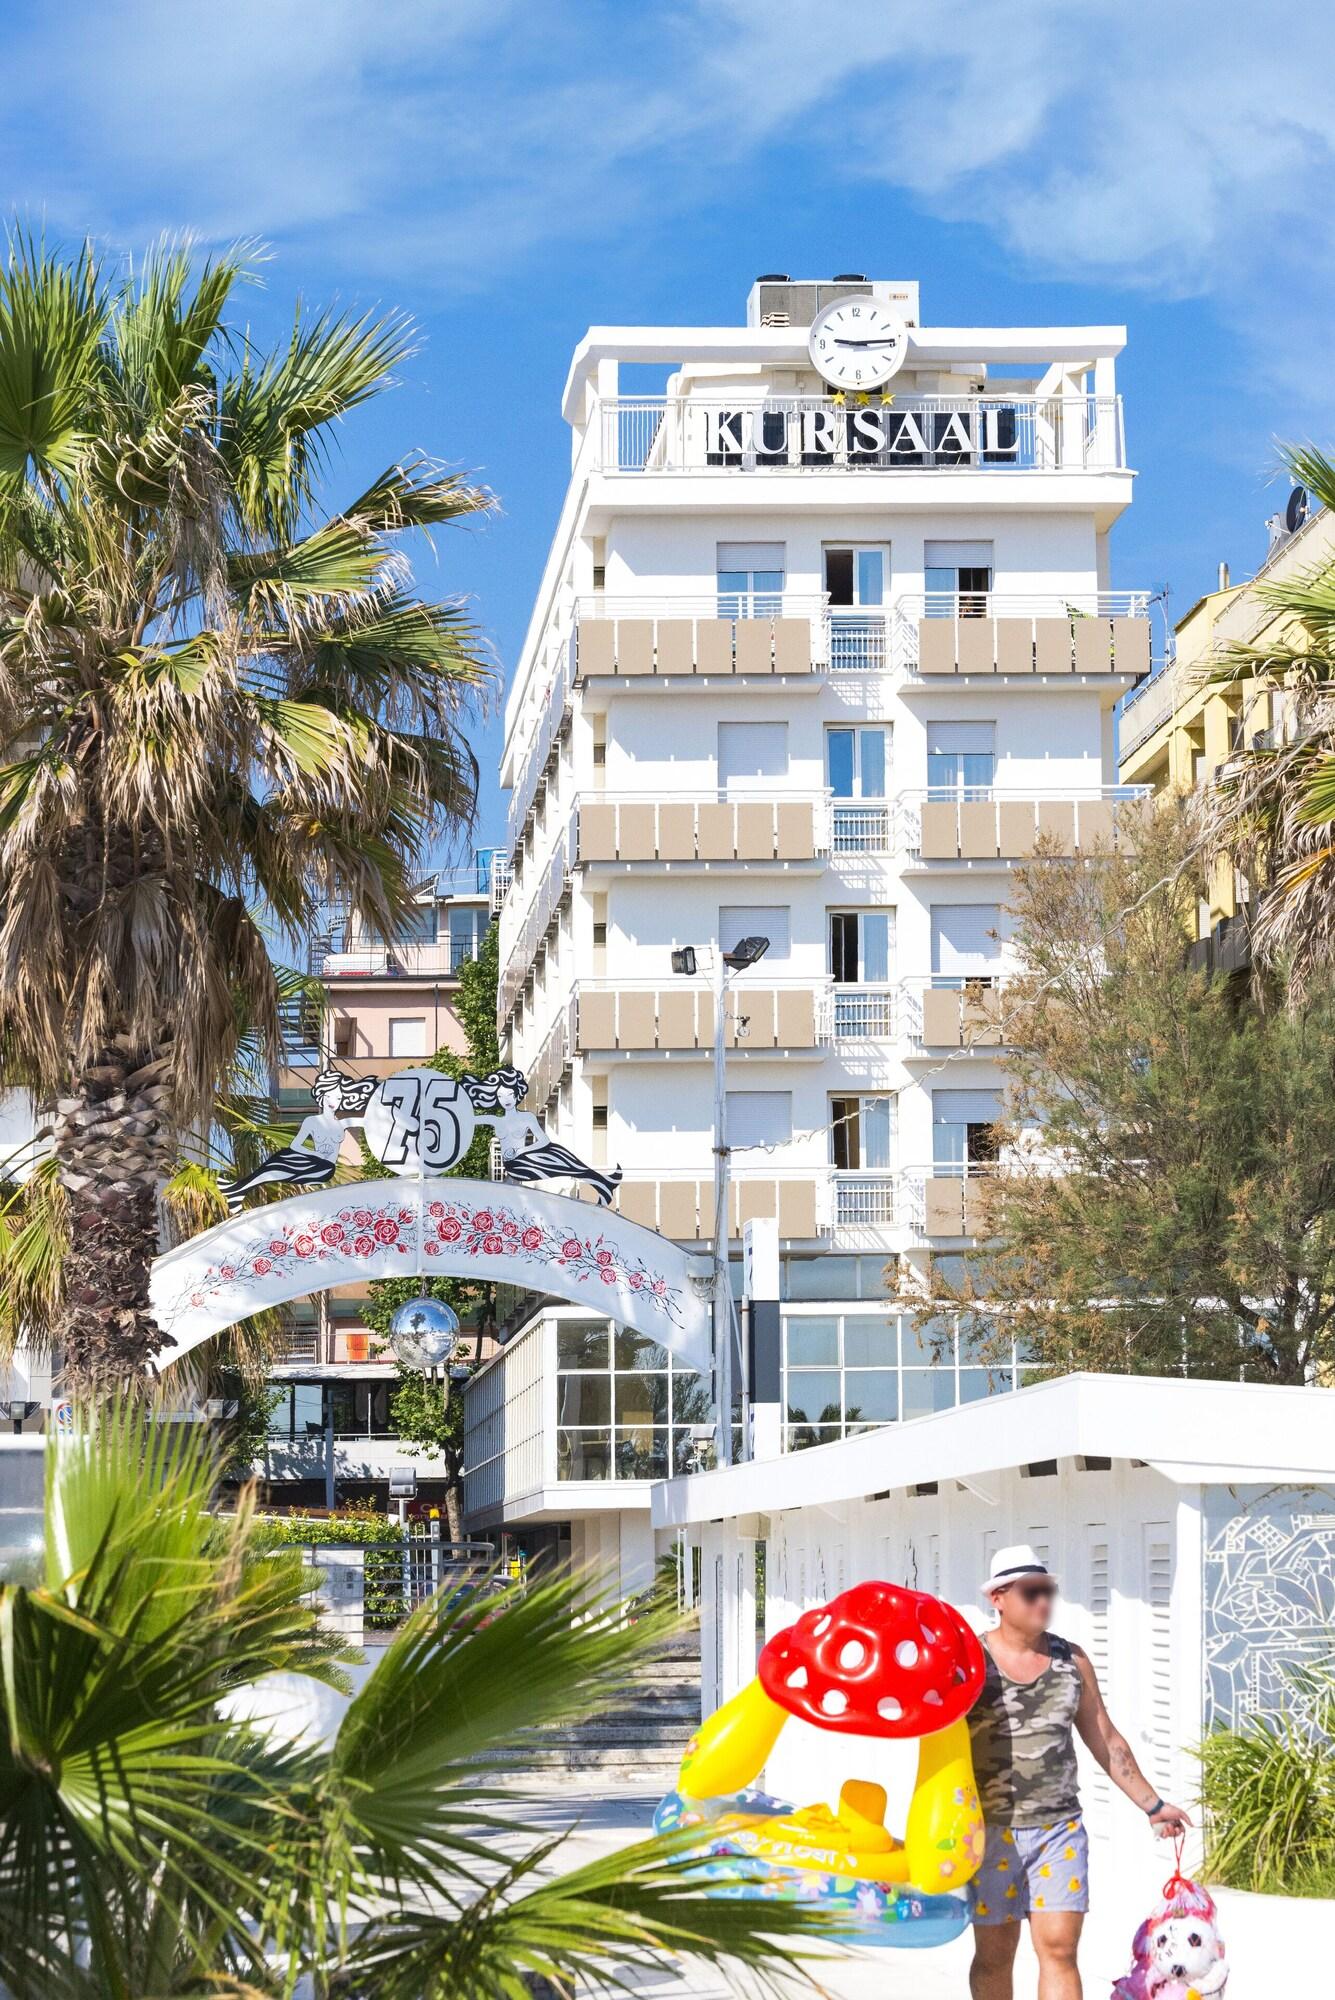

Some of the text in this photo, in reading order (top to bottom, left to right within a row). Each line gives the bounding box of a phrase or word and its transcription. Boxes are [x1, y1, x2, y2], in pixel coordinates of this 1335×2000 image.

[852, 307, 861, 318] 12
[819, 339, 826, 350] 9
[855, 369, 862, 380] 6
[704, 408, 1020, 454] KURSAAL
[381, 1077, 460, 1169] 75
